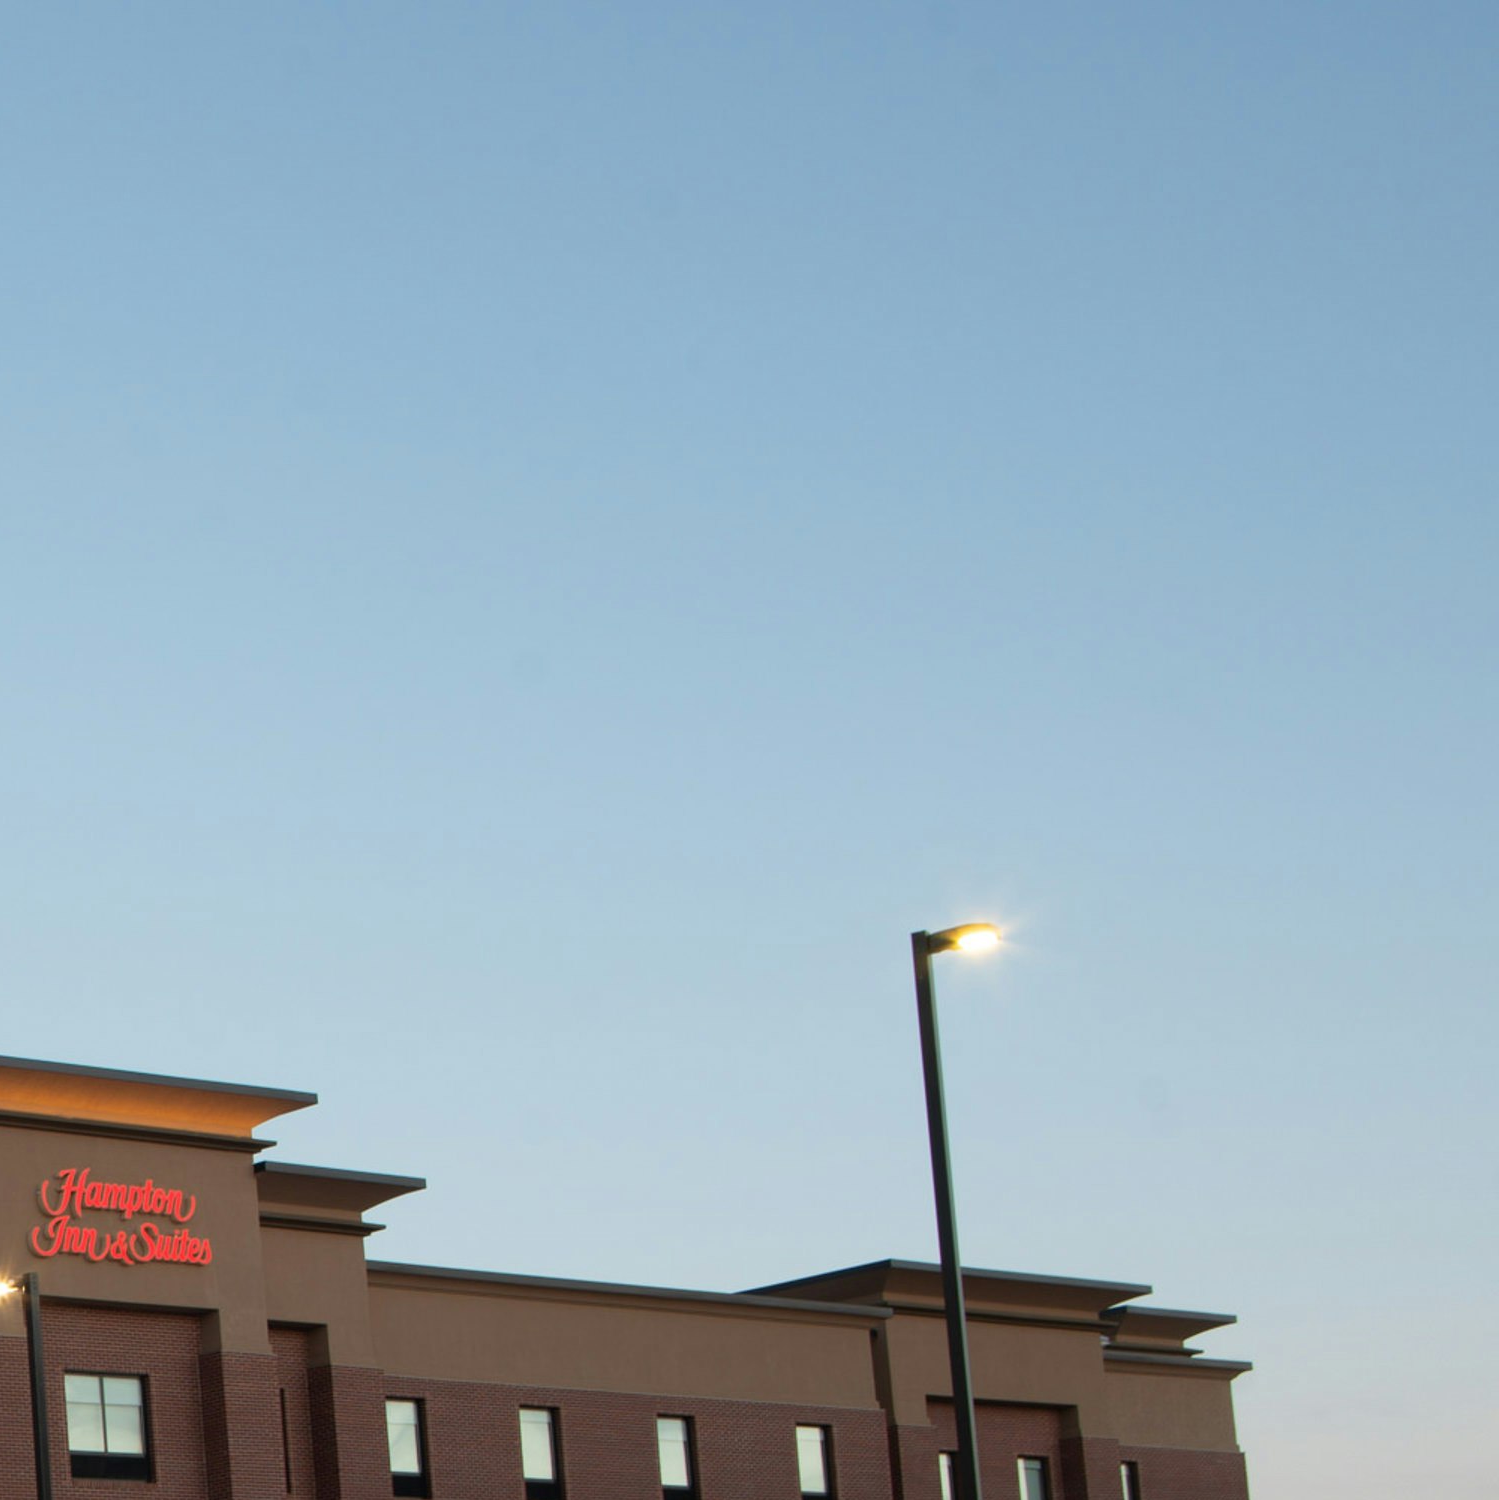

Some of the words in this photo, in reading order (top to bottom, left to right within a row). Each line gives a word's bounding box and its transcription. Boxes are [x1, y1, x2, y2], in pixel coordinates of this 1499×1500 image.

[41, 1167, 196, 1222] Hampton
[31, 1215, 111, 1261] Inn
[111, 1231, 134, 1265] &
[130, 1222, 212, 1265] Suites
